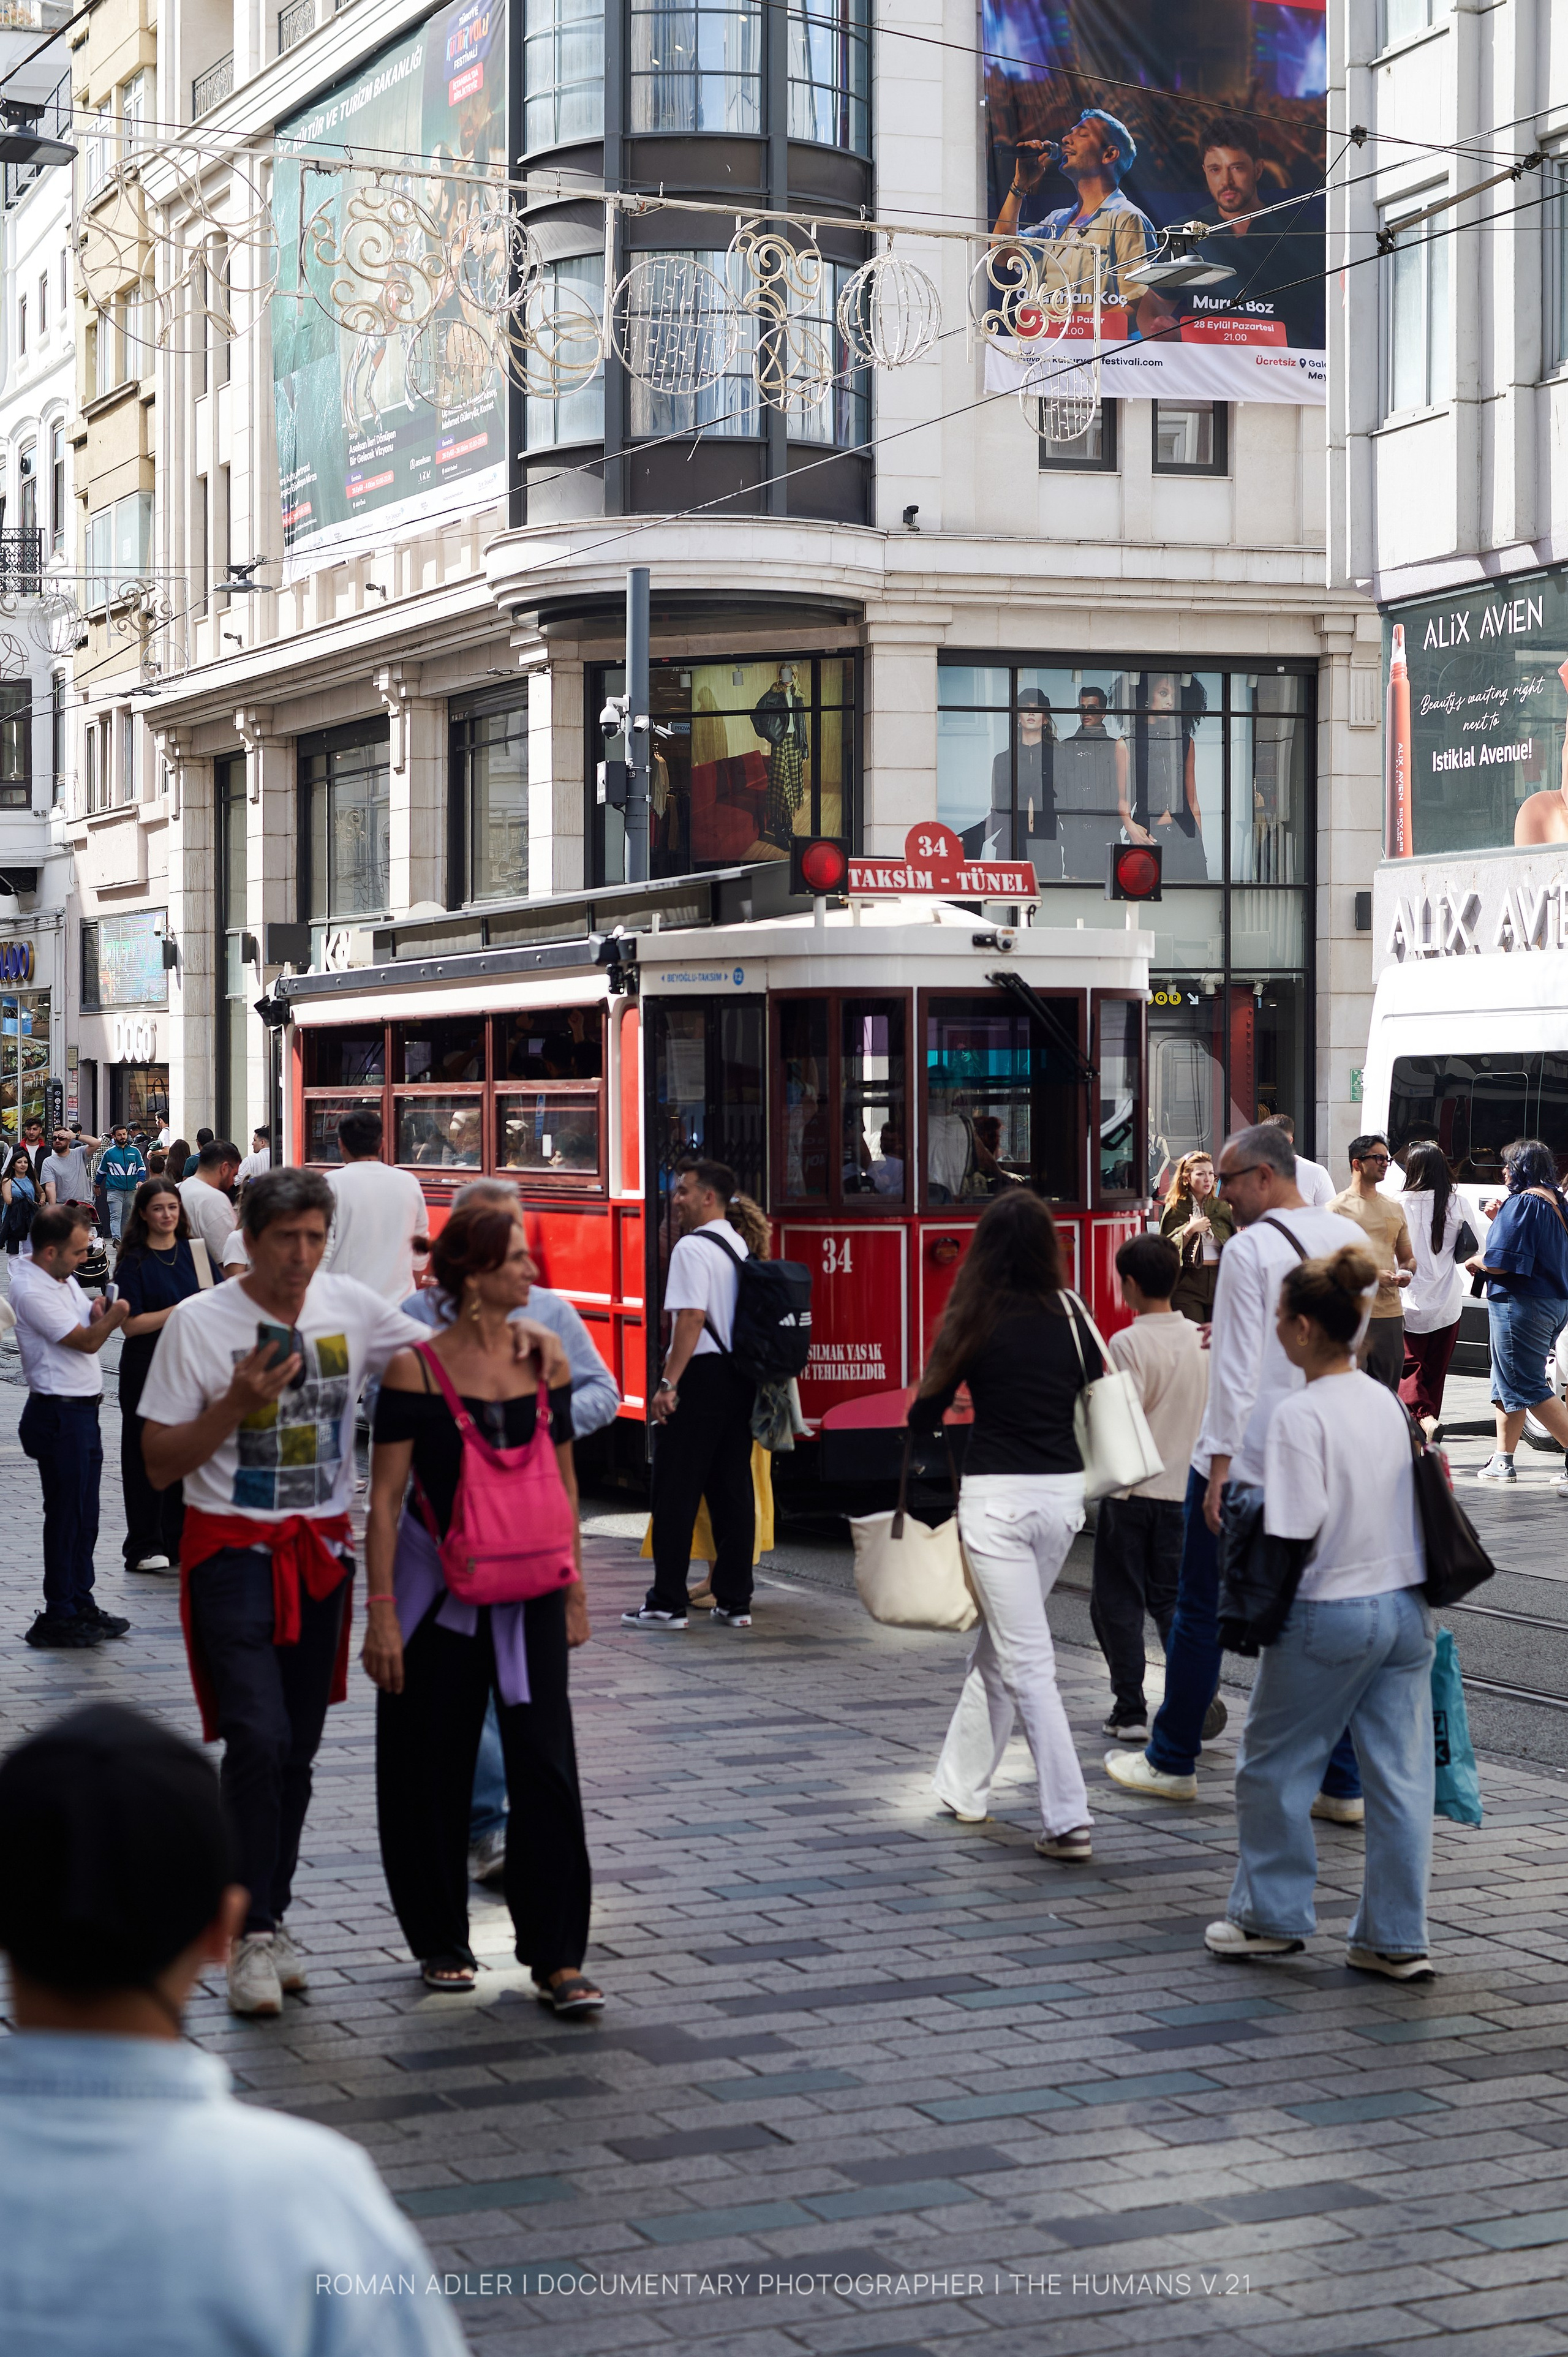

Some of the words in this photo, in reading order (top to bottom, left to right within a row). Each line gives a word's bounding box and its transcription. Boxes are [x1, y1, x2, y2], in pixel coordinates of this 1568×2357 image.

[459, 5, 479, 26] TÜRKİYE
[446, 25, 469, 61] KÜLTÜR
[453, 44, 478, 70] FESTİVALİ
[292, 115, 325, 154] KÜLTÜR
[325, 106, 339, 130] VE
[339, 82, 373, 121] TURİZM
[372, 44, 423, 98] BAKANLIĞI
[453, 79, 478, 101] BİRLİKTEYİZ
[1246, 300, 1275, 314] Boz
[1077, 315, 1105, 324] Pazr
[1194, 320, 1205, 329] 28
[1207, 320, 1231, 330] Eylül
[1232, 322, 1275, 332] Pazartesi
[1223, 333, 1247, 341] 21.00
[1256, 355, 1297, 367] Ücretsiz
[441, 417, 461, 430] Mehmet
[479, 400, 494, 414] Komet
[349, 442, 368, 454] Aselsan
[376, 430, 396, 444] Dönüşen
[356, 449, 375, 464] Gelecek
[375, 443, 394, 456] Vizyonu
[1467, 684, 1509, 706] waiting
[1512, 676, 1546, 703] right
[1463, 712, 1489, 731] next
[1488, 711, 1501, 730] to
[1432, 745, 1476, 772] Istiklal
[1479, 737, 1533, 767] Avenue!
[918, 835, 949, 858] 34
[848, 864, 935, 889] TAKSİM
[956, 867, 1028, 892] TÜNEL
[823, 1237, 853, 1274] 34
[846, 1343, 882, 1361] YASAK
